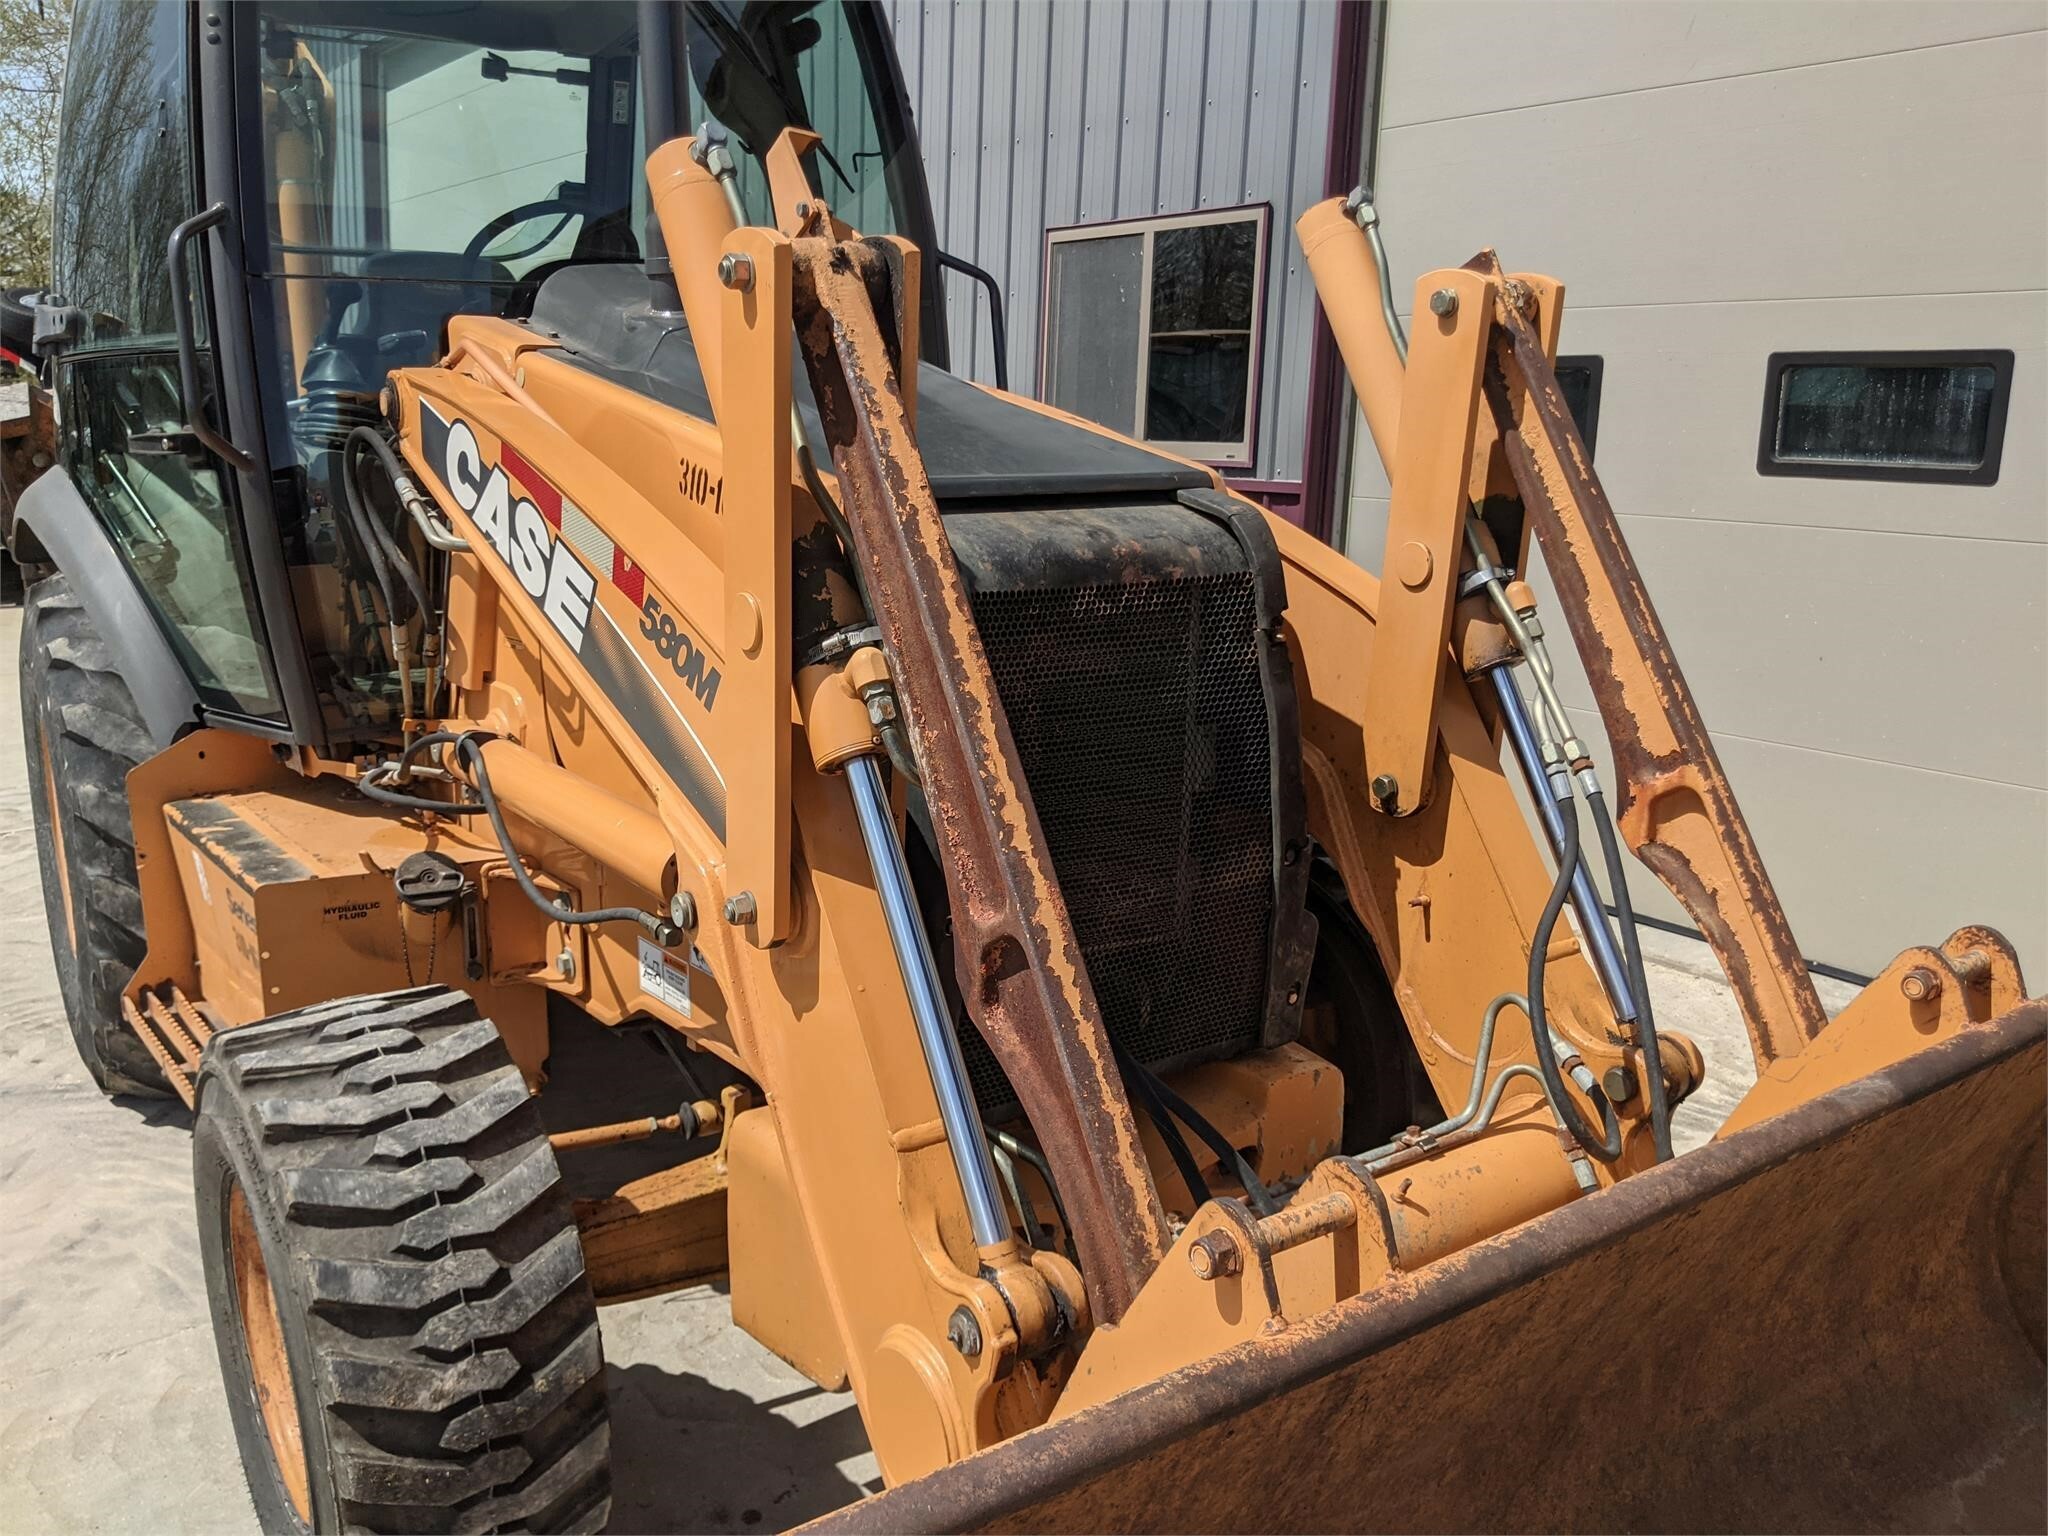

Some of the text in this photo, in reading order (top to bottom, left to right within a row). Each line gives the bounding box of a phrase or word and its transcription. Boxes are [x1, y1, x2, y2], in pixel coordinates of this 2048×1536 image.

[446, 421, 597, 654] CASE
[639, 594, 722, 712] 580M
[323, 902, 381, 915] HYDRAULIC
[338, 911, 368, 921] FLUID
